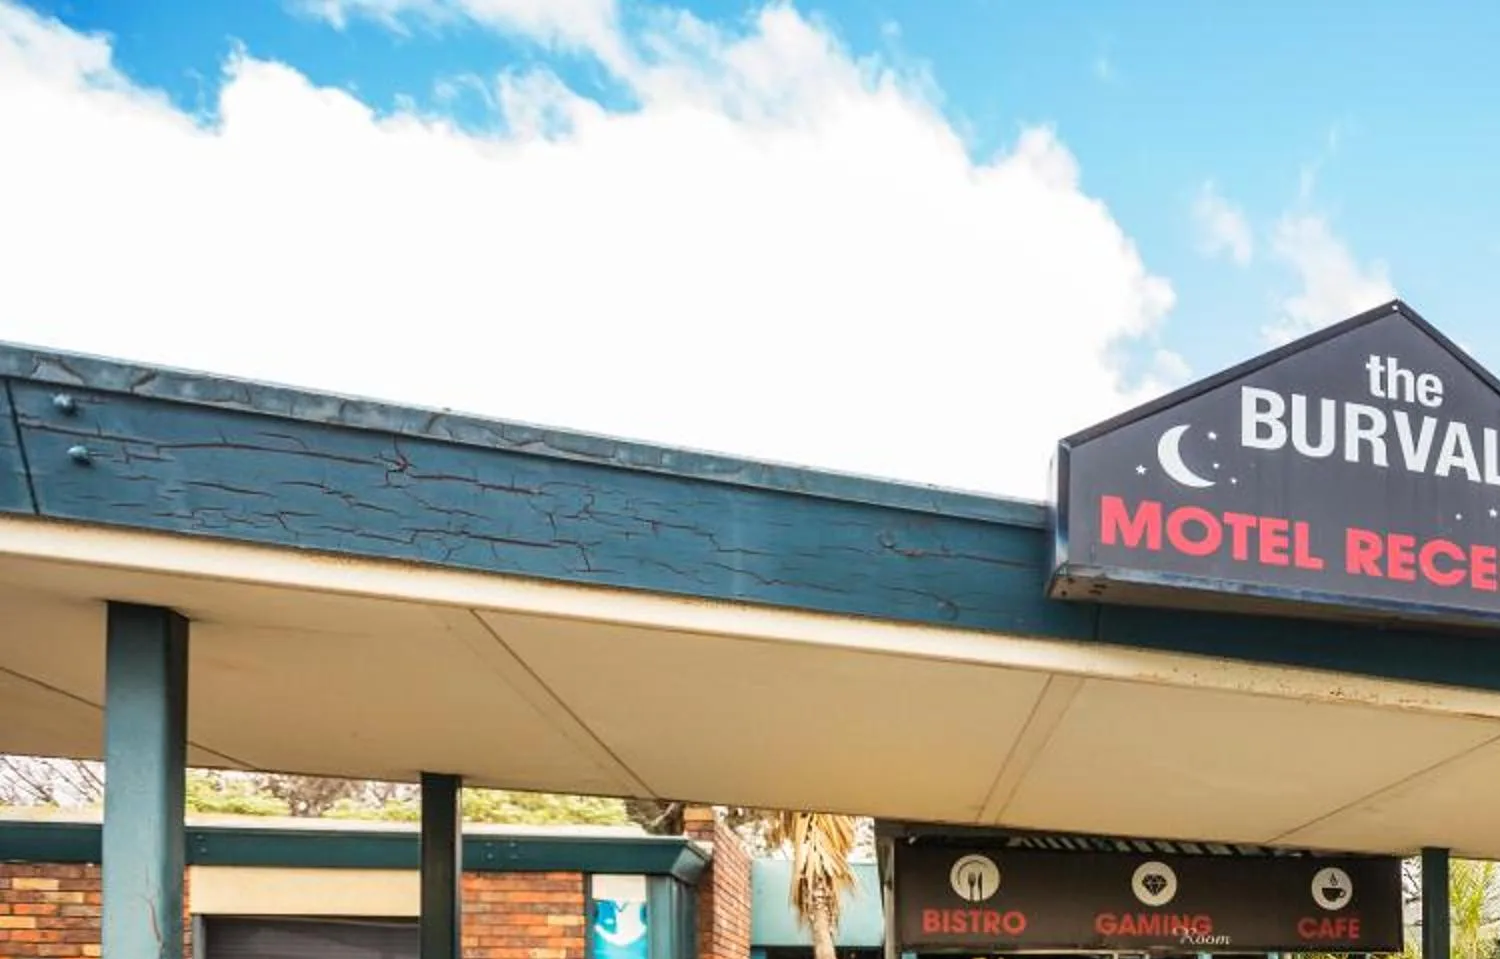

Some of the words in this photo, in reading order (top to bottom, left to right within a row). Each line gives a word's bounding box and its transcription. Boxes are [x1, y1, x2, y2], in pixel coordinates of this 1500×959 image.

[1366, 354, 1443, 407] the
[1100, 494, 1325, 571] MOTEL
[922, 908, 1028, 936] BISTRO
[1094, 912, 1214, 937] GAMING
[1172, 925, 1232, 945] Room
[1298, 916, 1361, 940] CAFE
